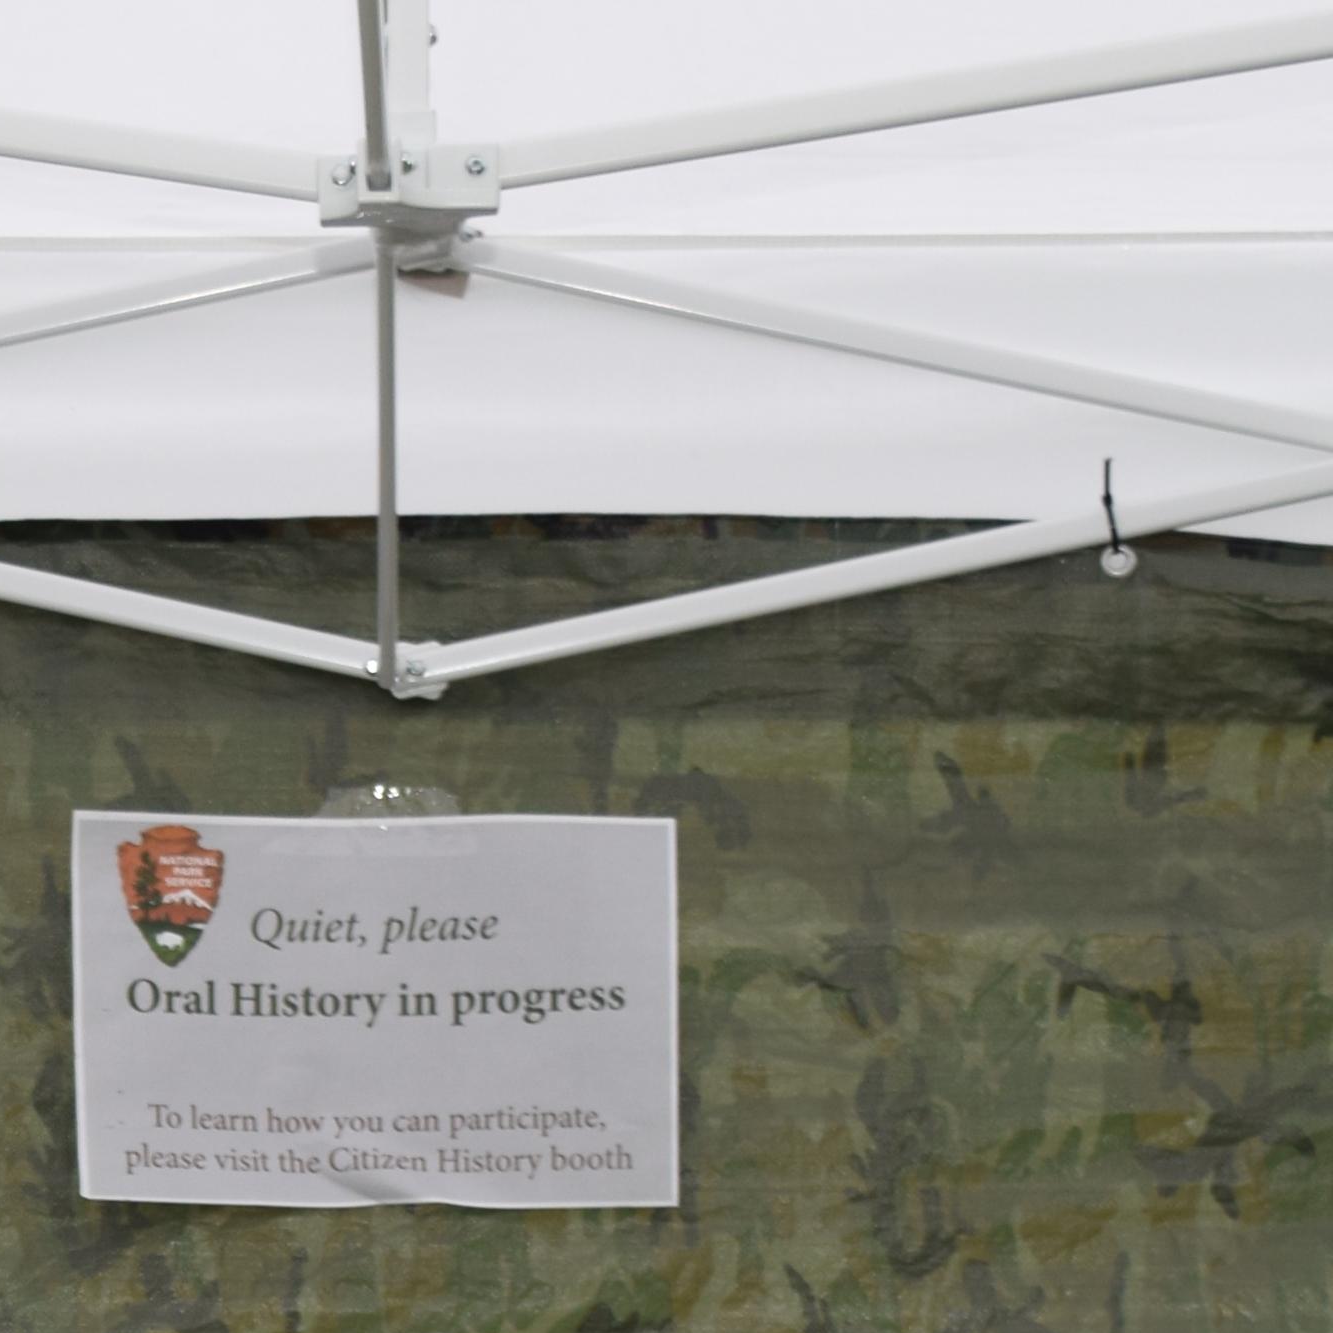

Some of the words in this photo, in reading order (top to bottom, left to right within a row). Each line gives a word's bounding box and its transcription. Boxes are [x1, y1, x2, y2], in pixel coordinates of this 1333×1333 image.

[159, 855, 216, 866] NATIONAL
[172, 866, 204, 877] PARK
[166, 877, 212, 888] SERVICE
[251, 908, 367, 950] Quiet,
[379, 906, 499, 954] please
[127, 978, 217, 1015] Oral
[230, 983, 387, 1028] History
[399, 983, 437, 1016] in
[451, 986, 625, 1026] progress
[147, 1103, 183, 1128] To
[189, 1104, 259, 1132] learn
[266, 1107, 324, 1133] how
[333, 1116, 384, 1139] you
[392, 1114, 440, 1133] can
[449, 1106, 606, 1140] participate,
[125, 1142, 206, 1175] please
[214, 1148, 270, 1172] visit
[277, 1149, 321, 1173] the
[328, 1147, 427, 1173] Citizen
[437, 1148, 543, 1180] History
[550, 1144, 633, 1171] booth
